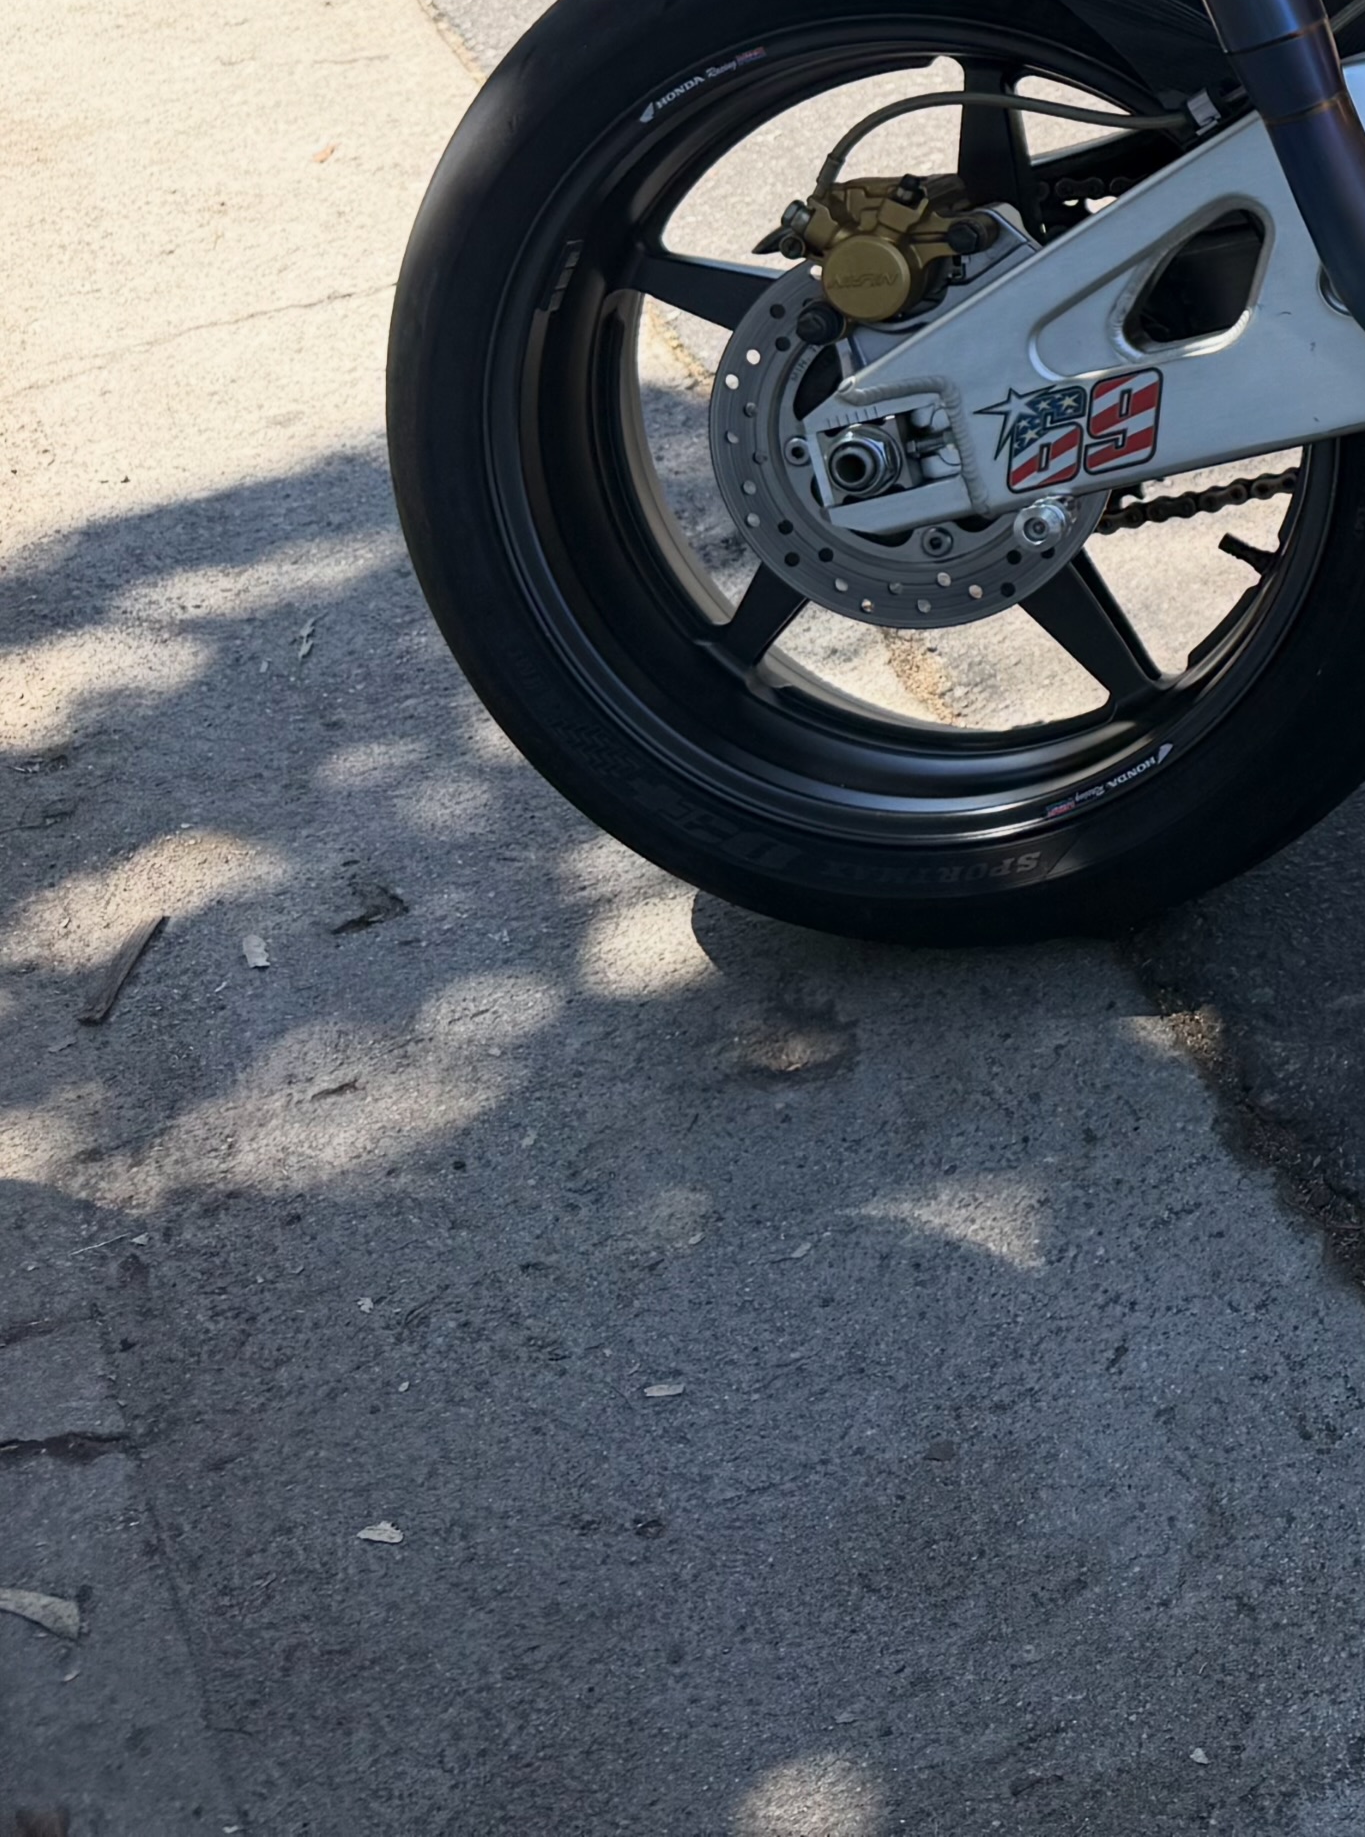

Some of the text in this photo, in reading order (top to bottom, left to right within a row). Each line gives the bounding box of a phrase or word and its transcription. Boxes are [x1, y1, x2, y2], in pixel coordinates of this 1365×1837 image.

[655, 76, 706, 109] HONDA
[1006, 366, 1164, 494] 69
[1106, 756, 1157, 788] HONDA
